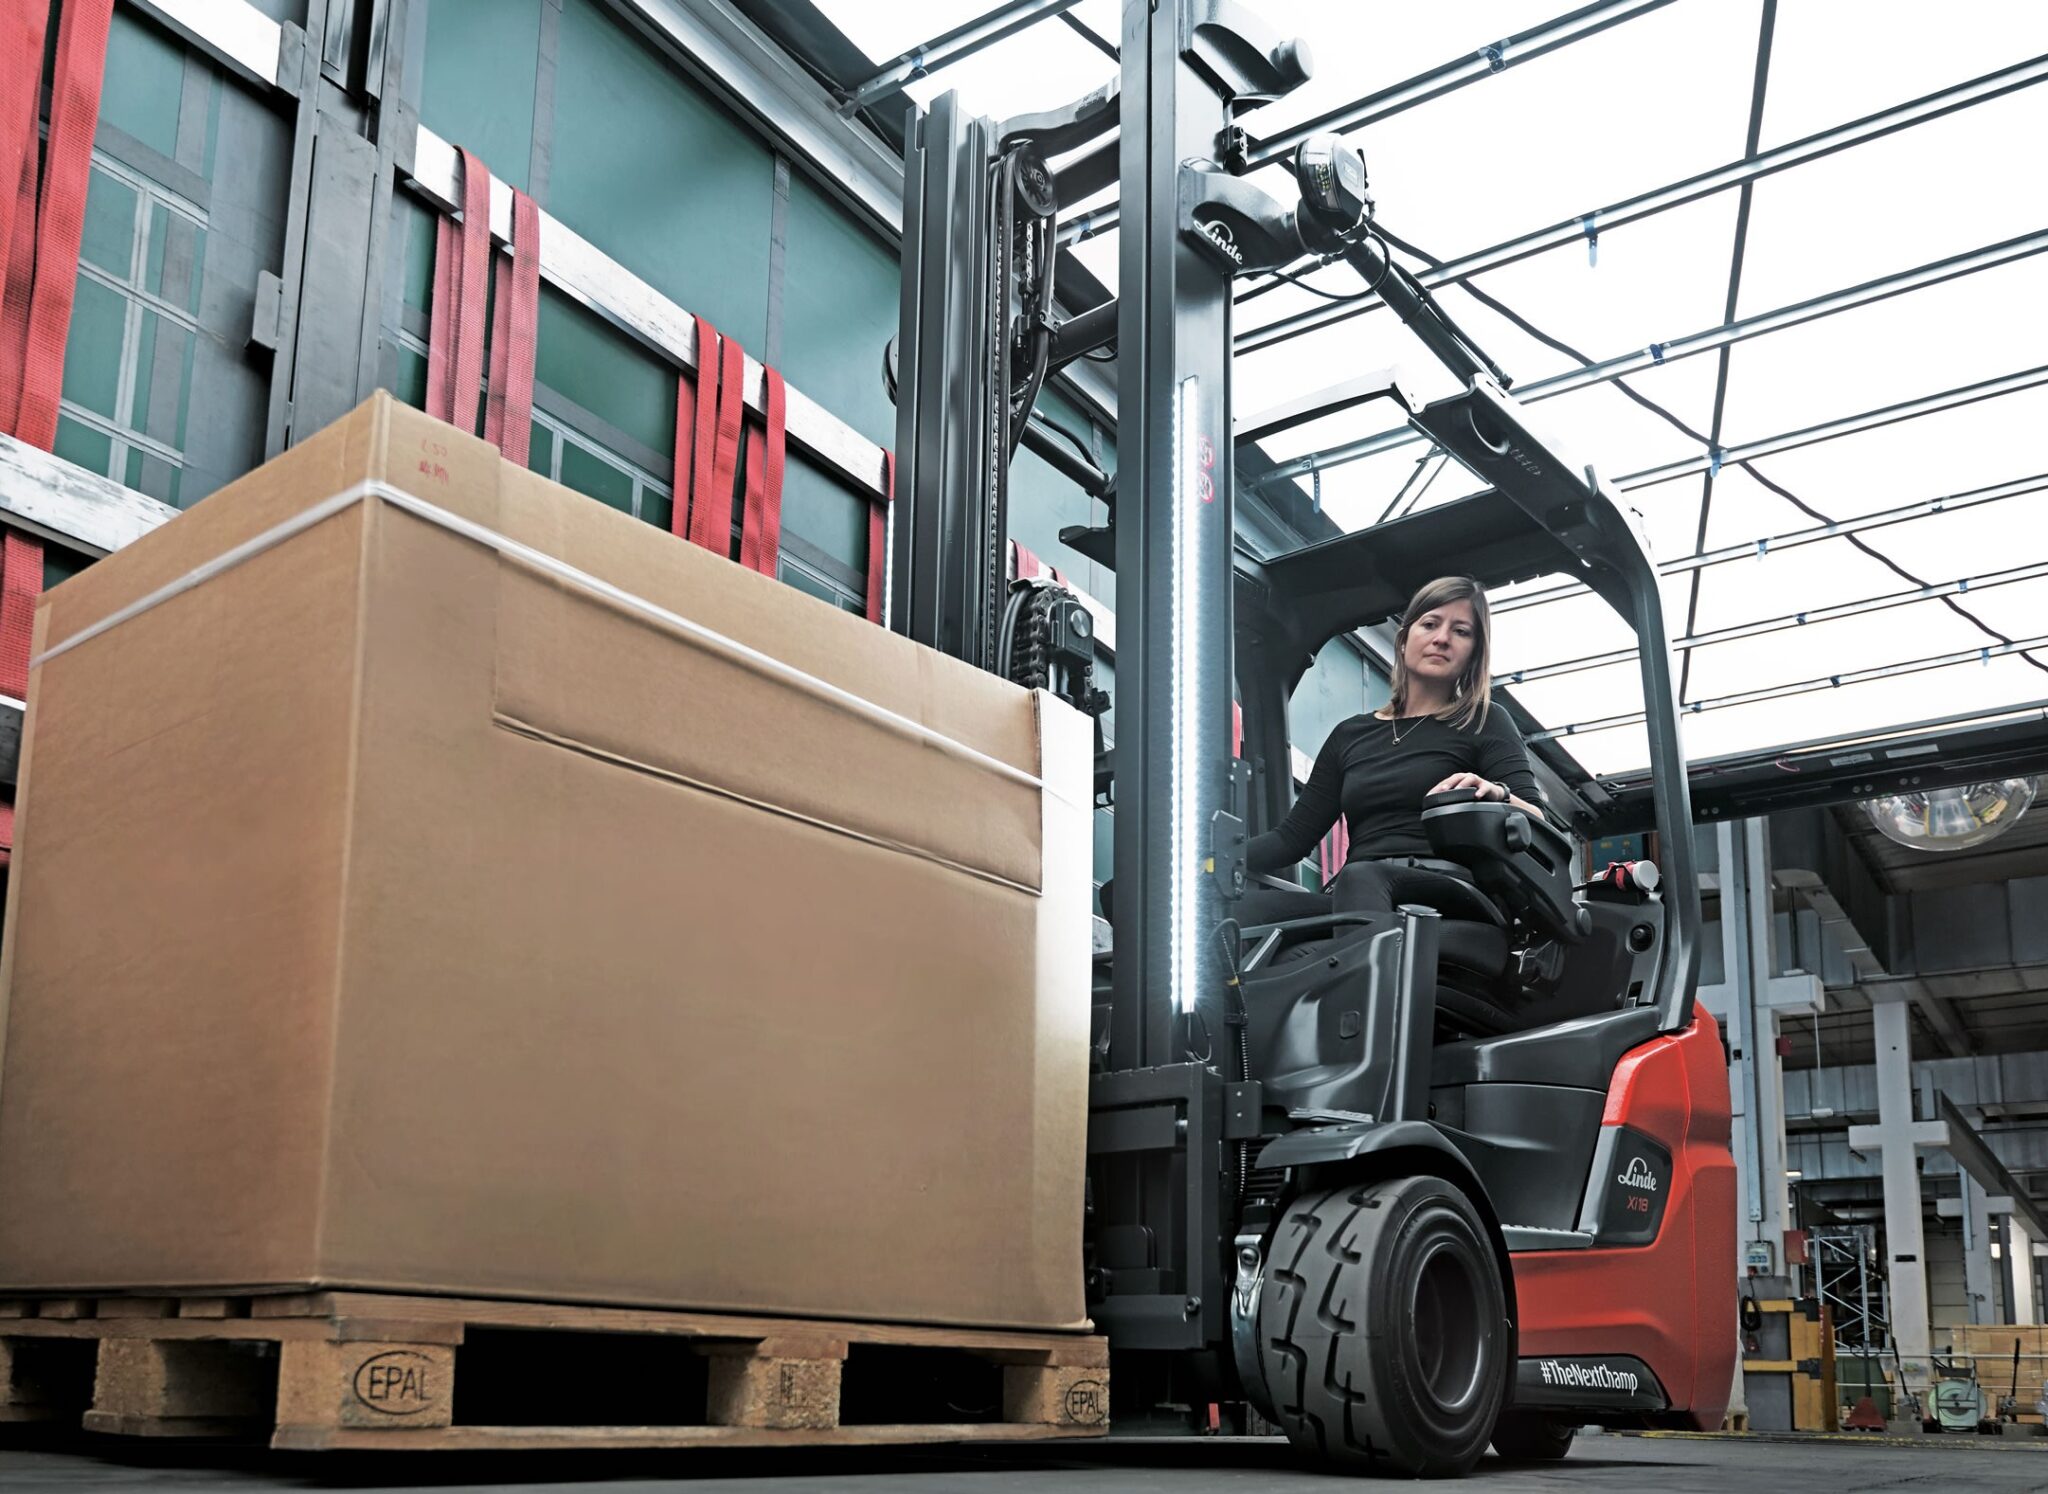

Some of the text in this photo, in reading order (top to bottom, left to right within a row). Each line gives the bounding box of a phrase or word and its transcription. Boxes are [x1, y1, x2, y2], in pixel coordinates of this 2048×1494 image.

[1193, 220, 1243, 265] Linde
[1617, 1156, 1657, 1191] Linde
[369, 1366, 432, 1400] EPAL
[1540, 1359, 1638, 1397] #TheNextChamp
[1072, 1391, 1104, 1416] EPAL
